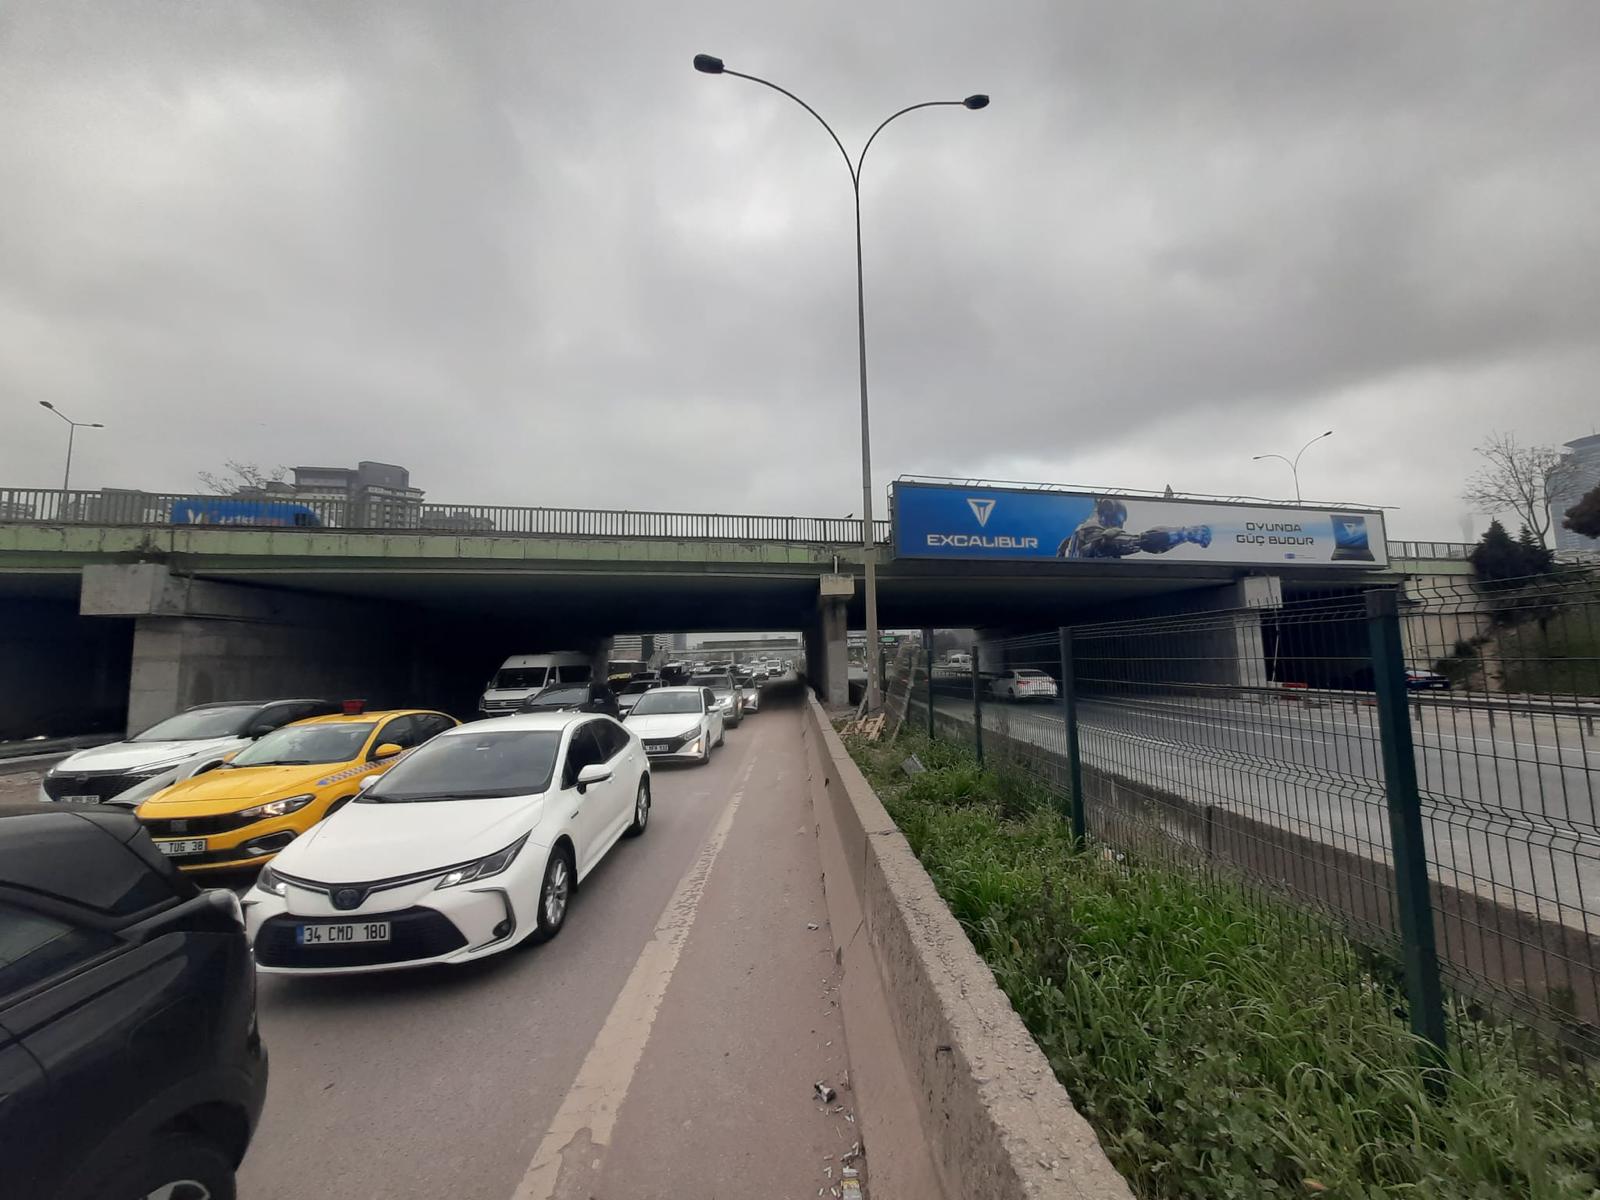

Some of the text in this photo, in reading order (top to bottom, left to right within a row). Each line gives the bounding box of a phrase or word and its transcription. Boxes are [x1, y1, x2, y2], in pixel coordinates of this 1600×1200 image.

[1246, 522, 1302, 532] OYUNDA
[926, 534, 1039, 549] EXCALIBUR
[1236, 533, 1314, 546] GÜÇ BUDUR
[305, 924, 387, 942] 34 CMD 180
